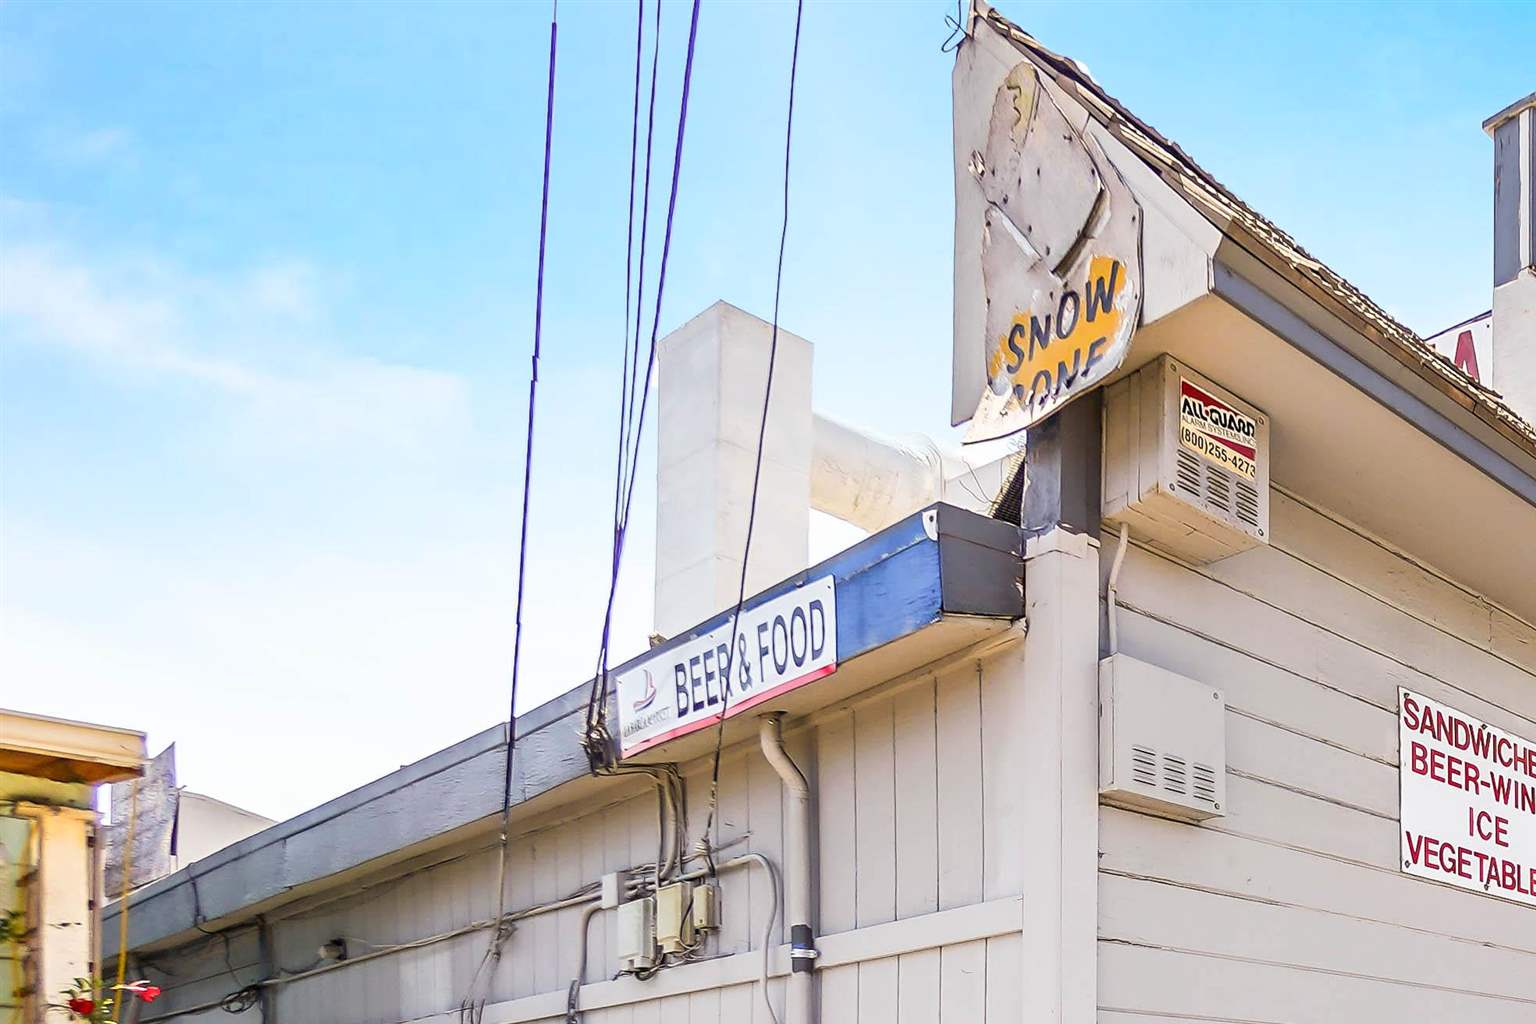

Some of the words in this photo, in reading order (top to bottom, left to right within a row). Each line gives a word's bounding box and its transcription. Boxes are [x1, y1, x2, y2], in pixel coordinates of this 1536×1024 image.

[1006, 259, 1120, 375] SNOW
[1181, 426, 1256, 478] (800)255-4273
[674, 642, 734, 718] BEER
[738, 632, 753, 692] &
[757, 599, 826, 684] FOOD
[1468, 806, 1510, 848] ICE
